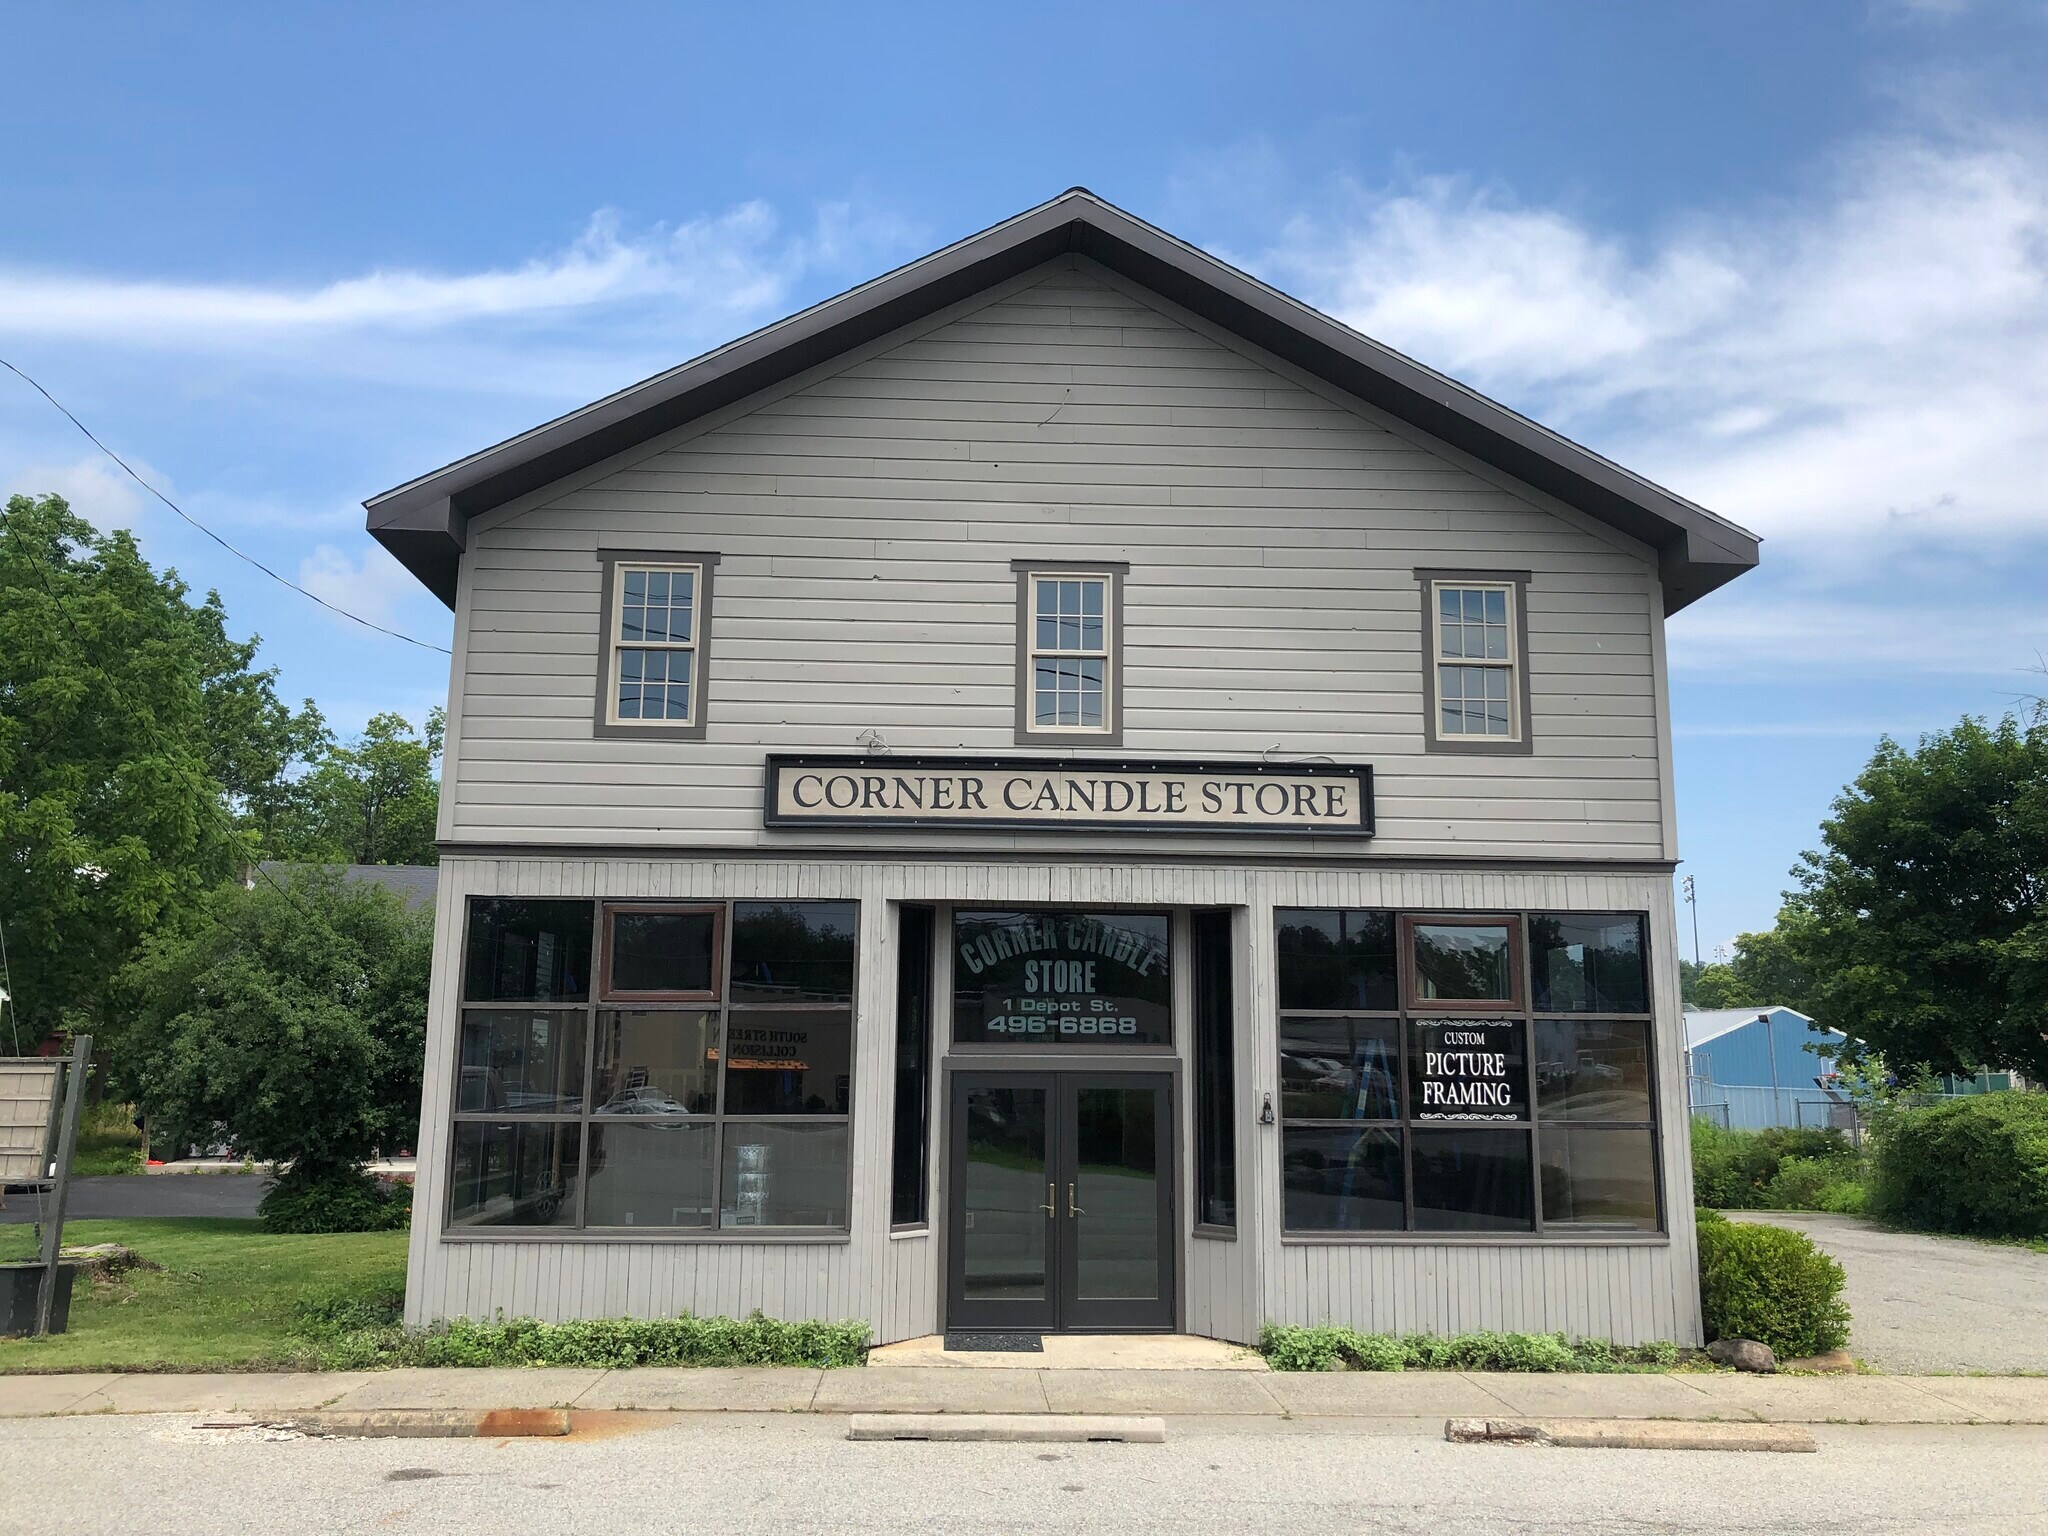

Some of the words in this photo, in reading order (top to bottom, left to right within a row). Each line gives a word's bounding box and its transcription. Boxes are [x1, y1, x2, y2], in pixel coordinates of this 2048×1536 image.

[793, 775, 988, 810] CORNER
[1002, 777, 1188, 814] CANDLE
[1201, 782, 1348, 818] STORE
[960, 917, 1058, 974] CORNER
[1067, 919, 1157, 977] CANDLE
[1025, 959, 1096, 993] STORE
[1002, 998, 1012, 1011] 1
[1020, 998, 1081, 1014] Depot
[1090, 999, 1119, 1012] St.
[987, 1015, 1137, 1034] 496-6868
[1444, 1031, 1485, 1045] CUSTOM
[1425, 1052, 1506, 1077] PICTURE
[1422, 1081, 1511, 1106] FRAMING
